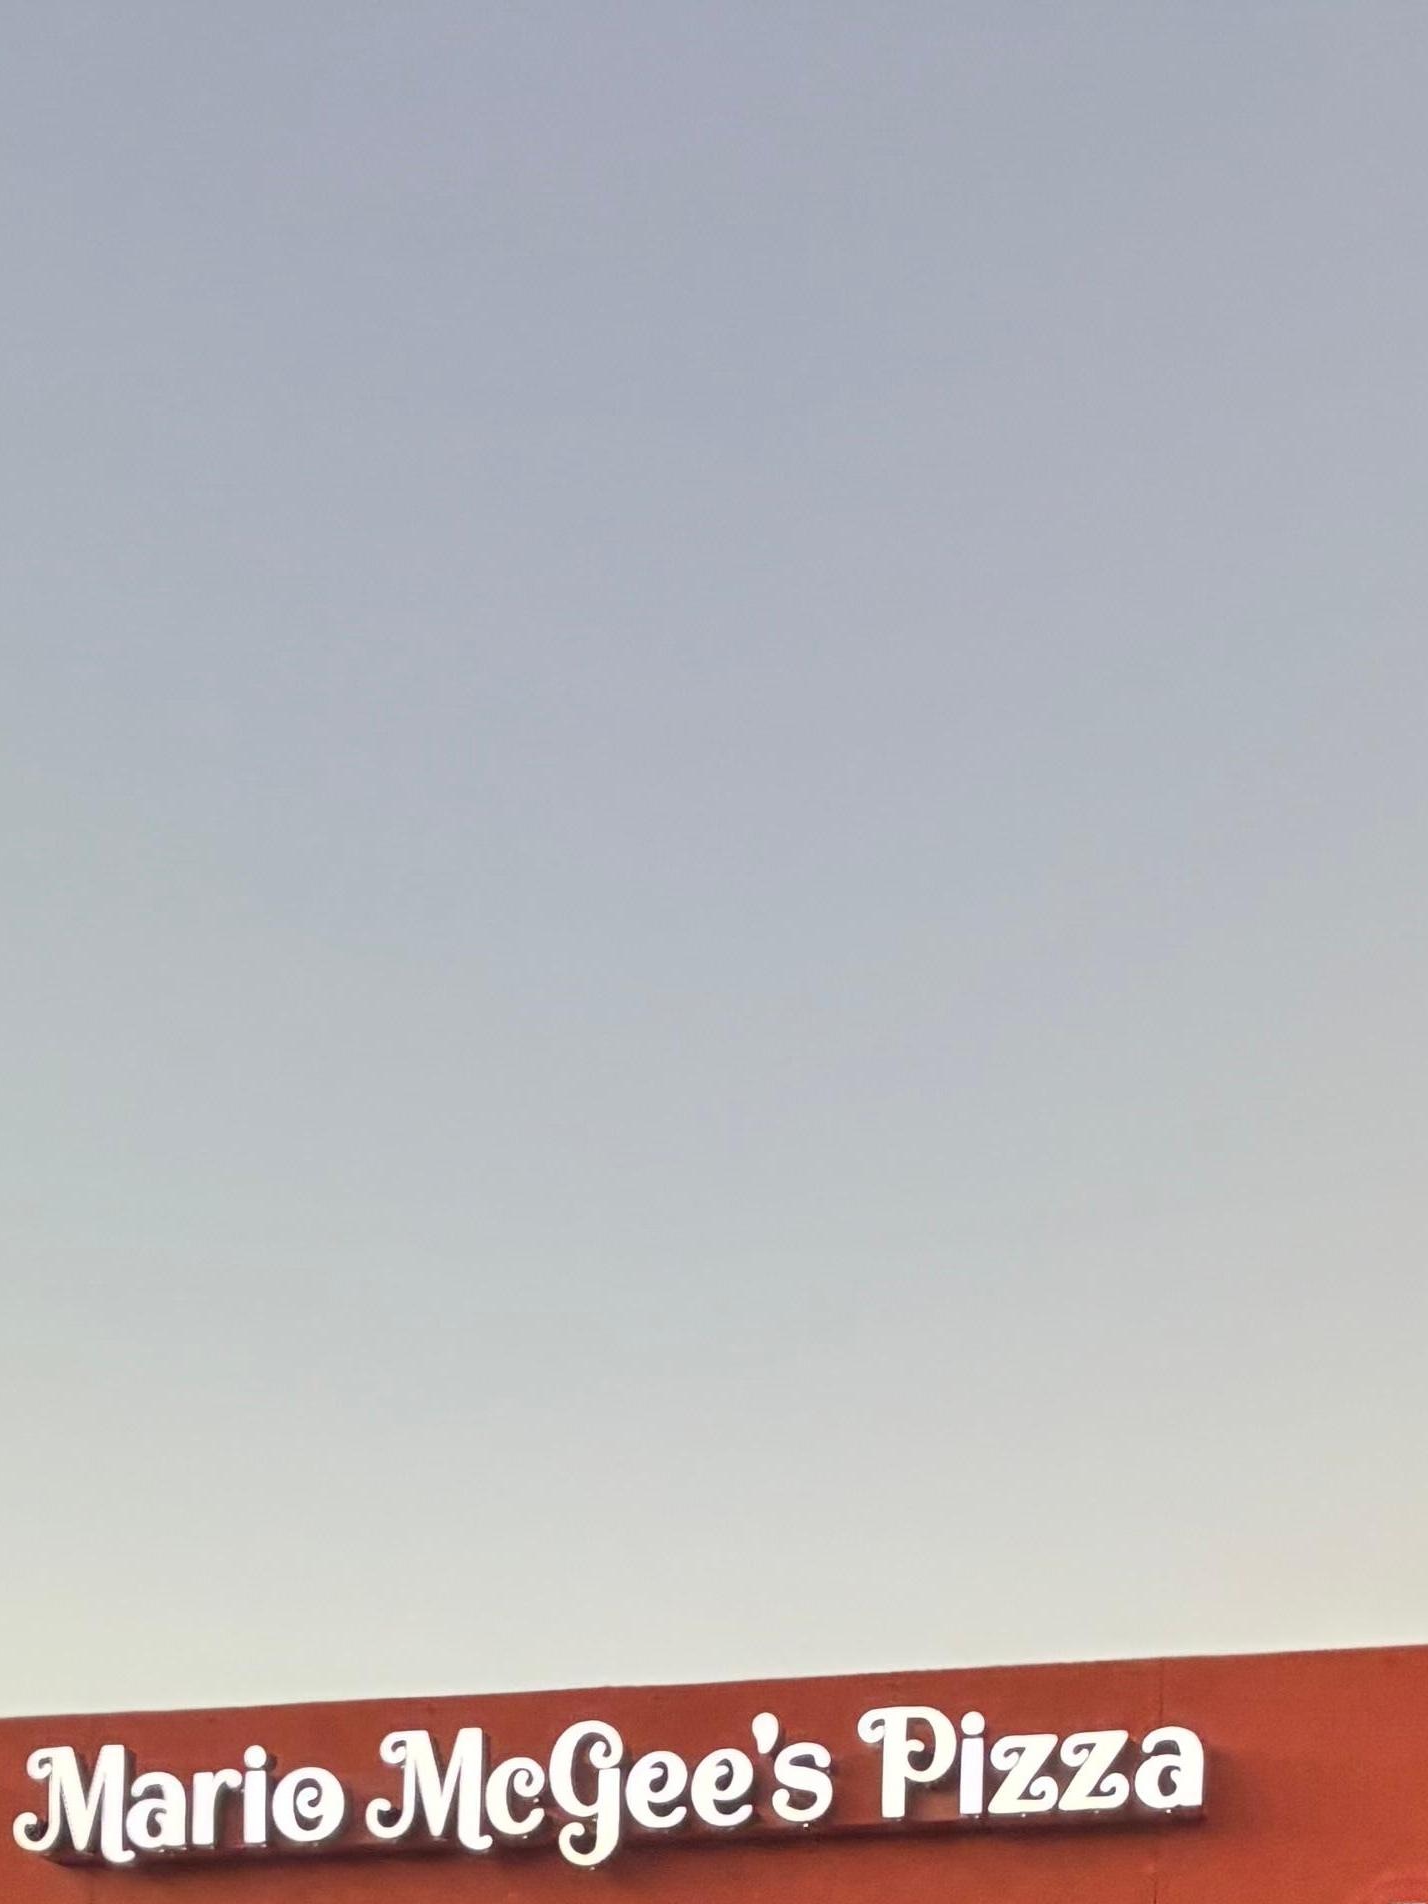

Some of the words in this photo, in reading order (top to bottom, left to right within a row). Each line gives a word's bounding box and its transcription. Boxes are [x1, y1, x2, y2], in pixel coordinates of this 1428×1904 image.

[13, 1744, 345, 1863] Mario
[365, 1711, 833, 1866] McGee's
[857, 1705, 1204, 1818] Pizza
